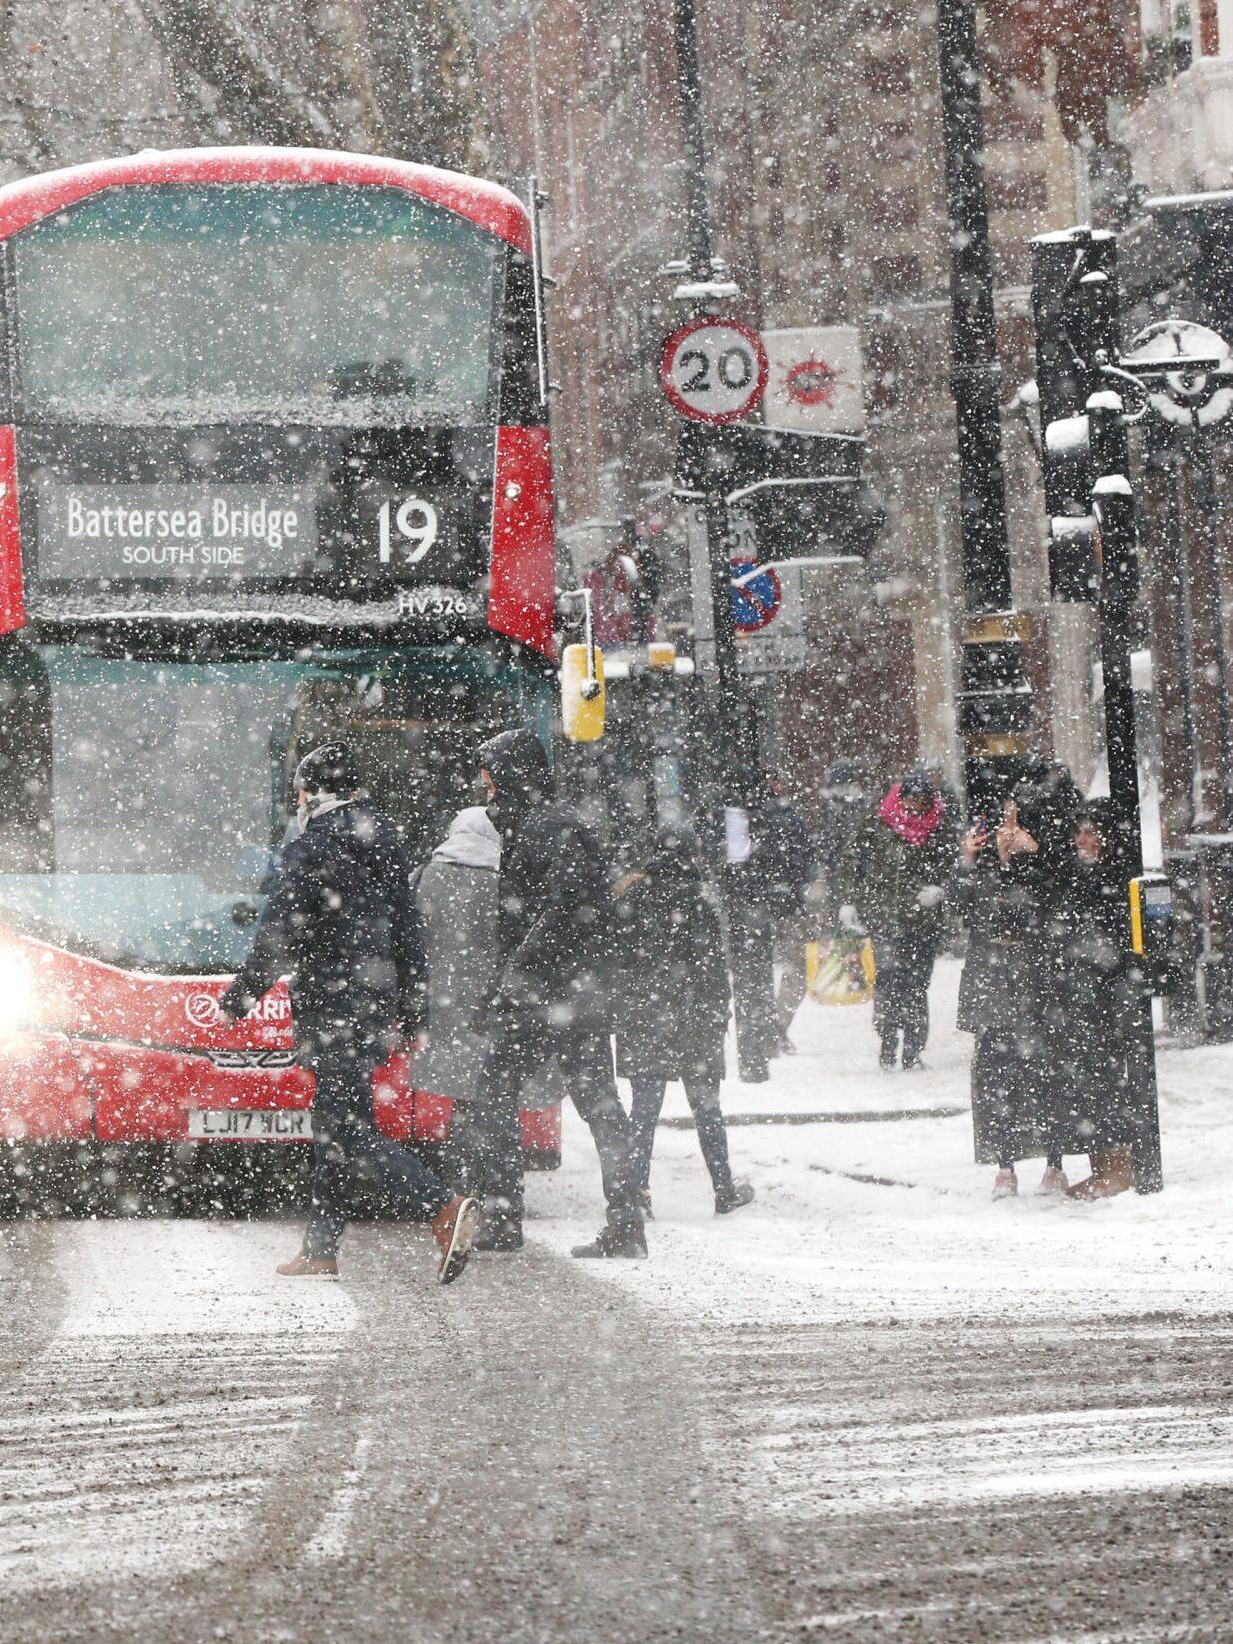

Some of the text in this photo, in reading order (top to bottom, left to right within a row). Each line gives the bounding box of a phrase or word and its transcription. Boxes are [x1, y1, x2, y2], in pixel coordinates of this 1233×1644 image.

[679, 347, 752, 393] 20
[67, 498, 298, 548] Battersea Bridge
[378, 499, 438, 563] 19
[122, 546, 245, 565] SOUTH SIDE
[399, 597, 468, 614] HV 326
[203, 1112, 253, 1134] LJ17
